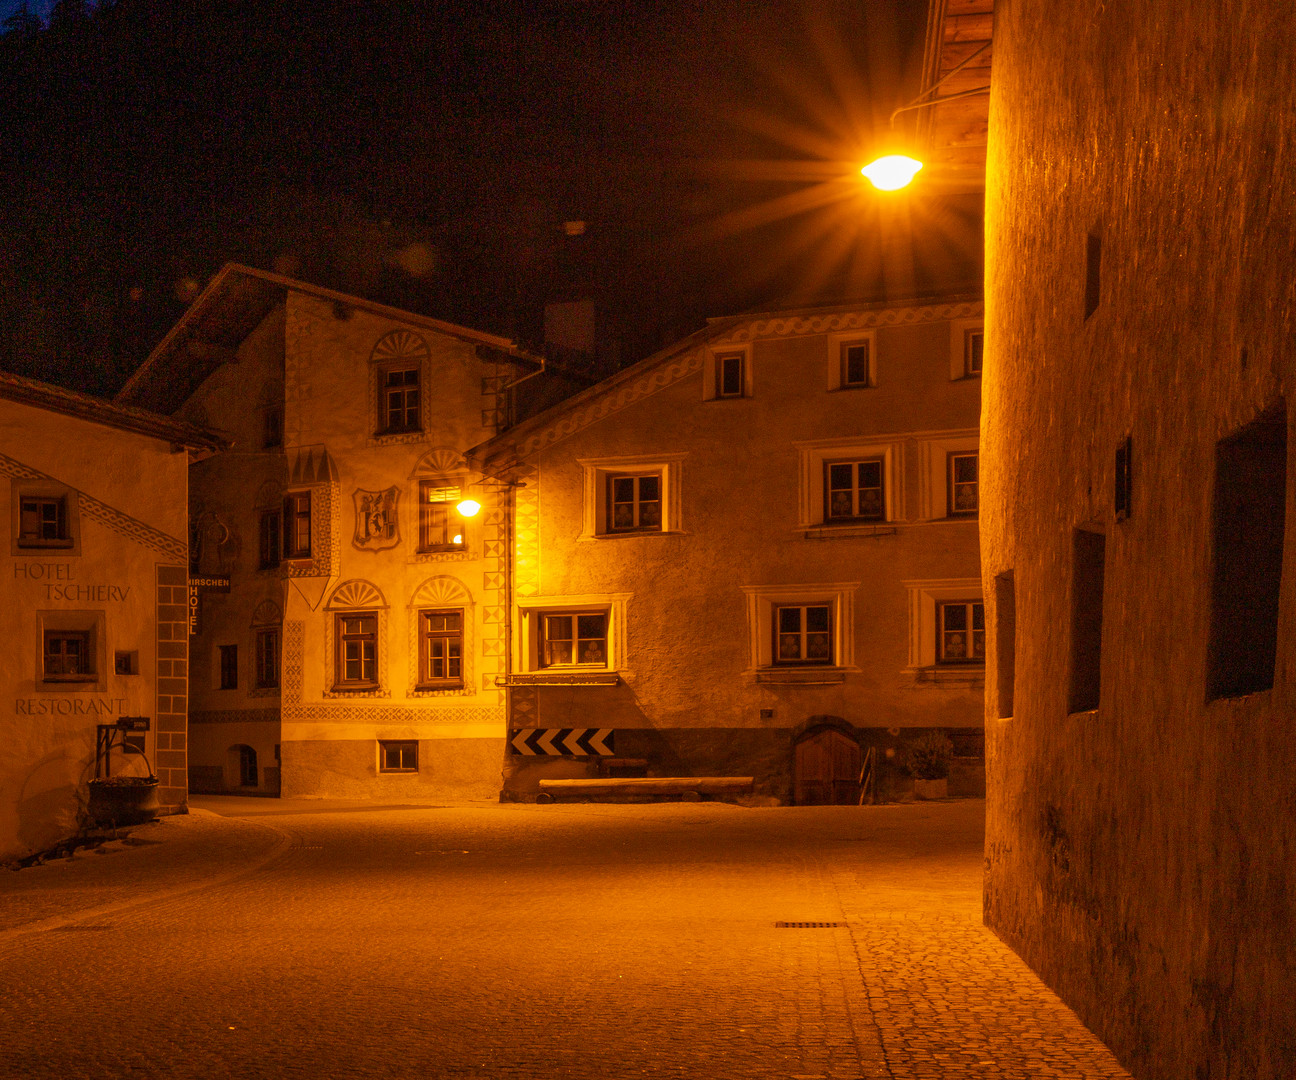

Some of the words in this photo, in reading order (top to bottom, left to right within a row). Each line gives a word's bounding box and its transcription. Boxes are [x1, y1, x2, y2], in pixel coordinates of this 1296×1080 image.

[14, 562, 76, 581] HOTEL
[44, 584, 131, 603] TSCHIERV
[189, 586, 199, 635] HOTEL
[15, 698, 128, 716] RESTORANT
